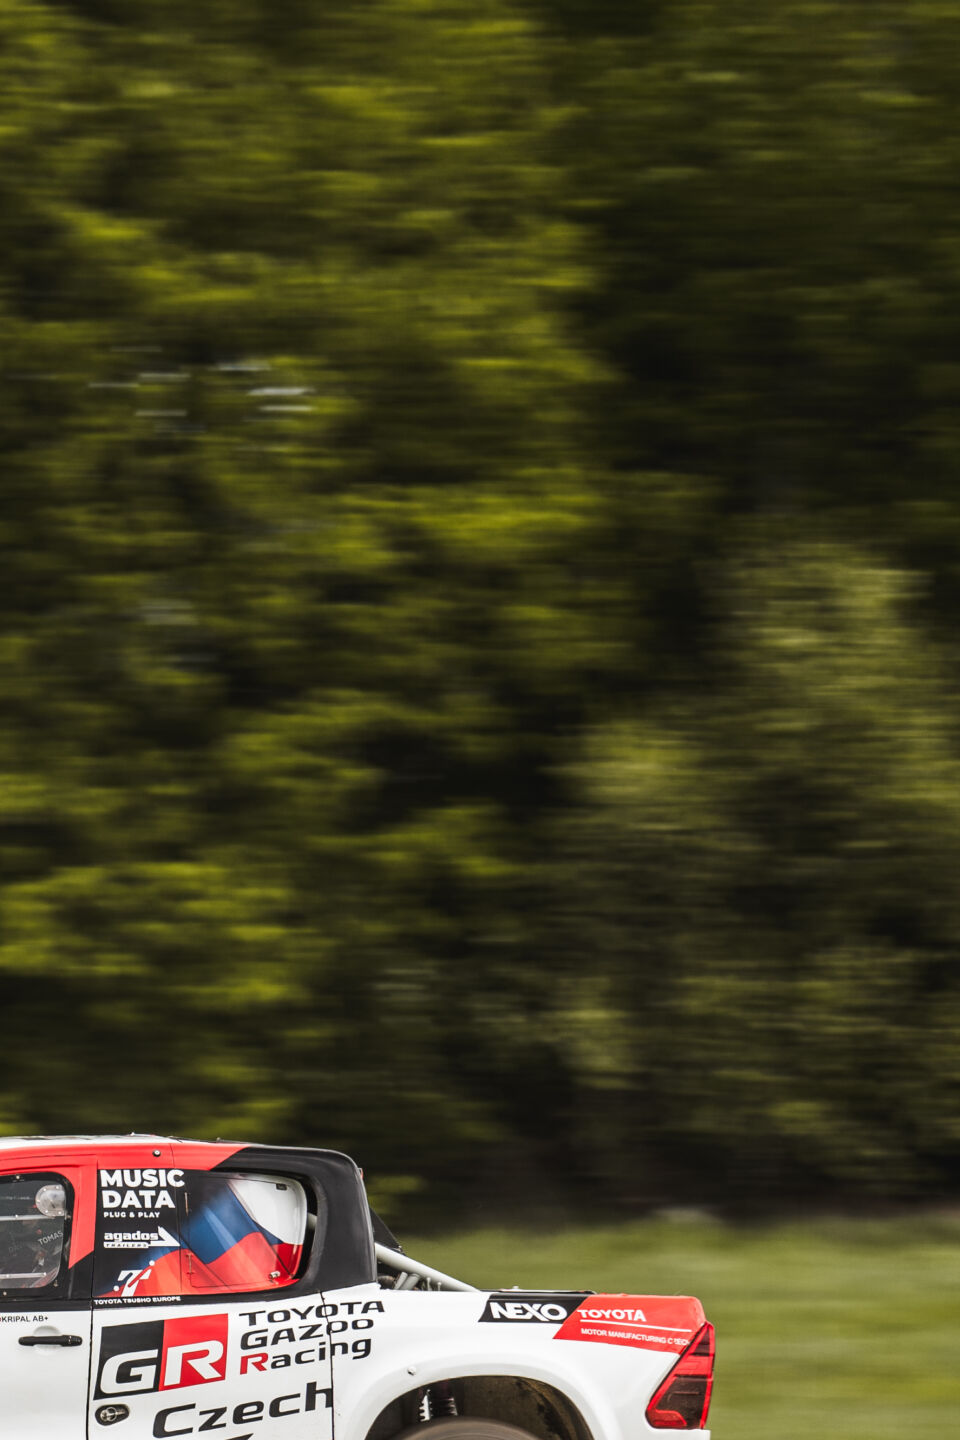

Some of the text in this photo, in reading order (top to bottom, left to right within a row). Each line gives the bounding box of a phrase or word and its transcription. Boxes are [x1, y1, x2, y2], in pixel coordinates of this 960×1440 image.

[100, 1169, 185, 1187] MUSIC
[102, 1190, 176, 1208] DATA
[37, 1230, 64, 1245] TOMAS
[104, 1231, 158, 1242] agados
[239, 1300, 386, 1327] TOYOTA
[490, 1302, 568, 1321] NEXO
[577, 1309, 647, 1321] TOYOTA
[240, 1318, 374, 1350] GAZOO
[581, 1328, 607, 1337] MOTOR
[608, 1331, 667, 1345] MANUFACTURING
[239, 1338, 372, 1375] Racing
[99, 1340, 224, 1394] GR
[152, 1382, 334, 1438] Czech
